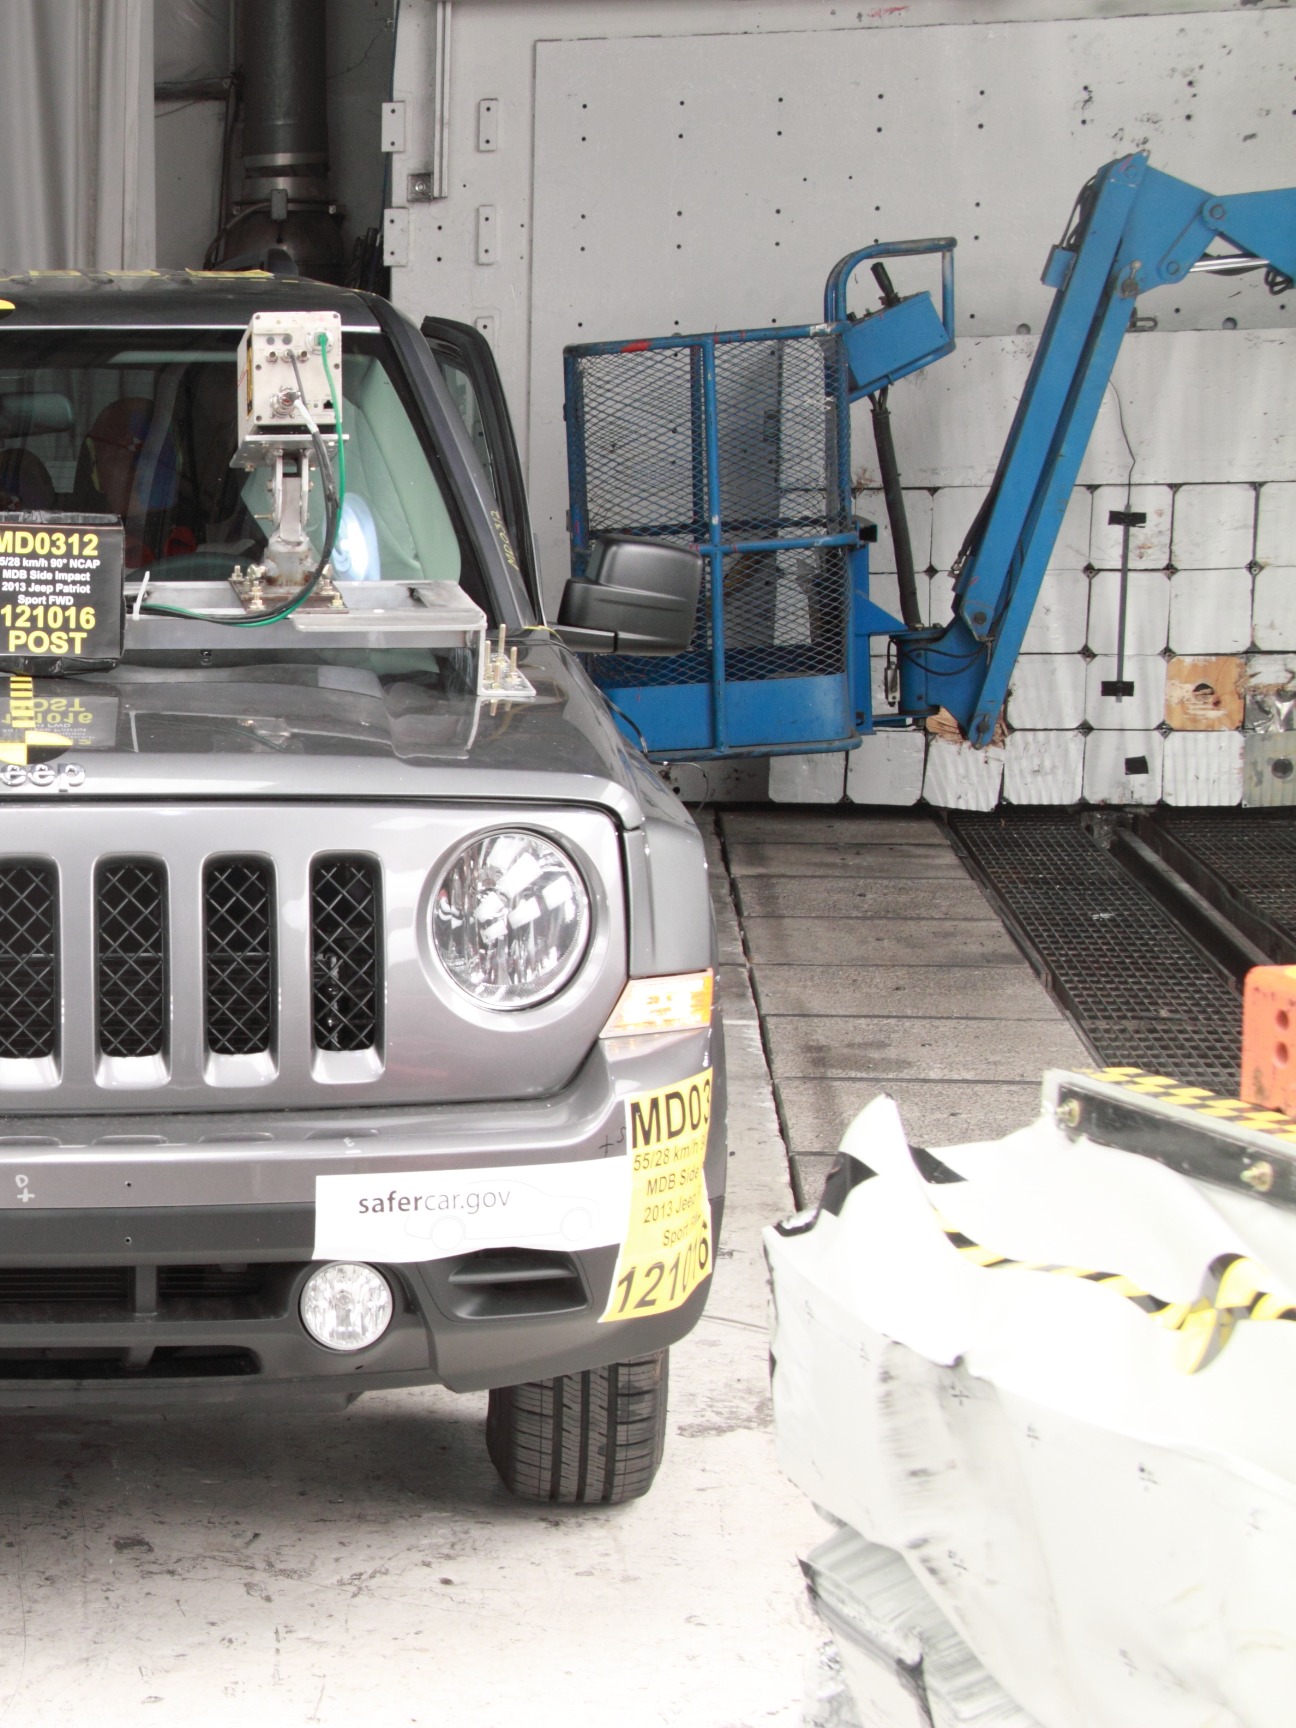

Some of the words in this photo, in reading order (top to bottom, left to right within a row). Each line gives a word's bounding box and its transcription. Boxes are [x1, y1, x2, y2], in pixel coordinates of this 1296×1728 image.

[22, 557, 48, 568] km/h
[69, 558, 101, 569] NCAP
[2, 569, 28, 580] MDB
[29, 570, 53, 580] Side
[55, 571, 91, 582] Impact
[1, 582, 27, 592] 2013
[28, 582, 54, 594] Jeep
[55, 583, 91, 594] Patriot
[17, 595, 47, 606] Sport
[48, 595, 74, 606] FWD
[0, 605, 96, 630] 121016
[8, 630, 88, 655] POST
[633, 1148, 670, 1171] 55/28
[647, 1173, 676, 1196] MDB
[679, 1164, 700, 1186] Side
[358, 1190, 511, 1215] safercar.gov
[644, 1200, 673, 1223] 2013
